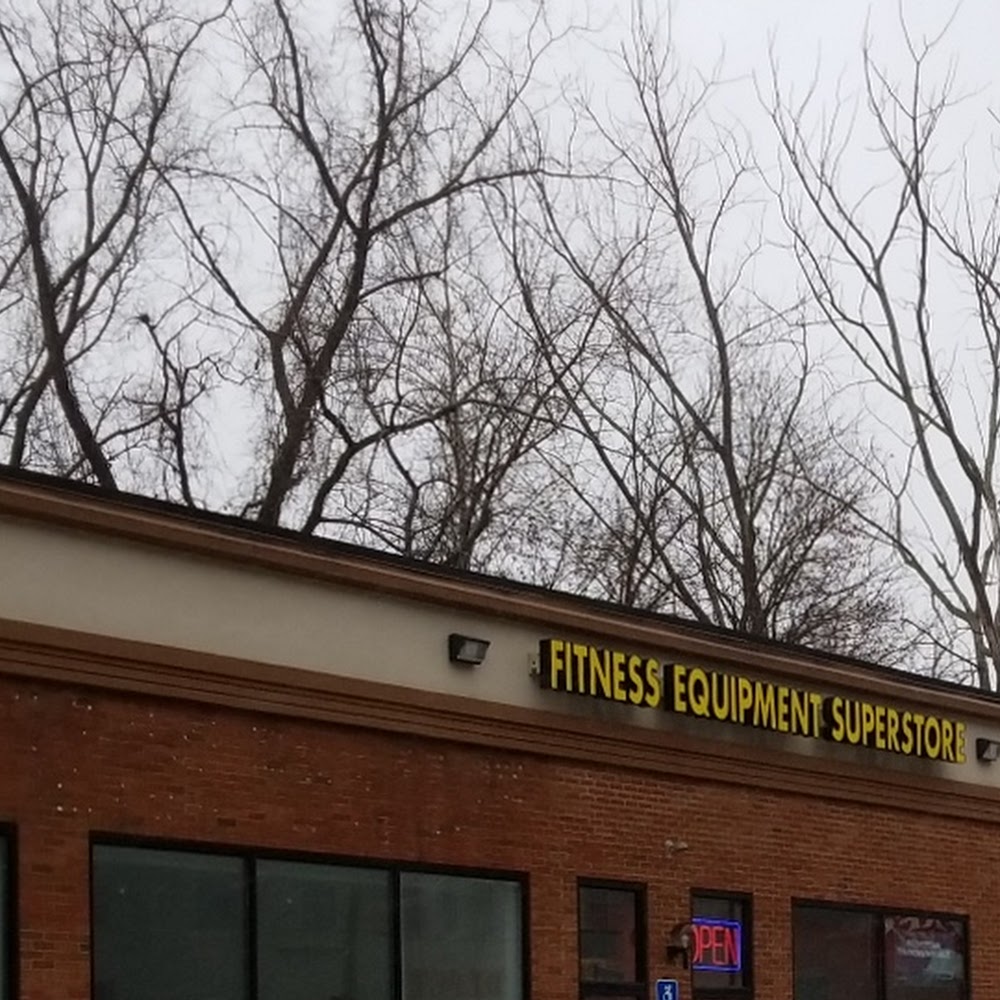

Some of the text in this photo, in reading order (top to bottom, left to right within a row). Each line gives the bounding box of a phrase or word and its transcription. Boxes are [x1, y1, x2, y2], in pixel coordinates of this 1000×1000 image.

[550, 639, 966, 763] FITNESS EQUIPMENT SUPERSTORE
